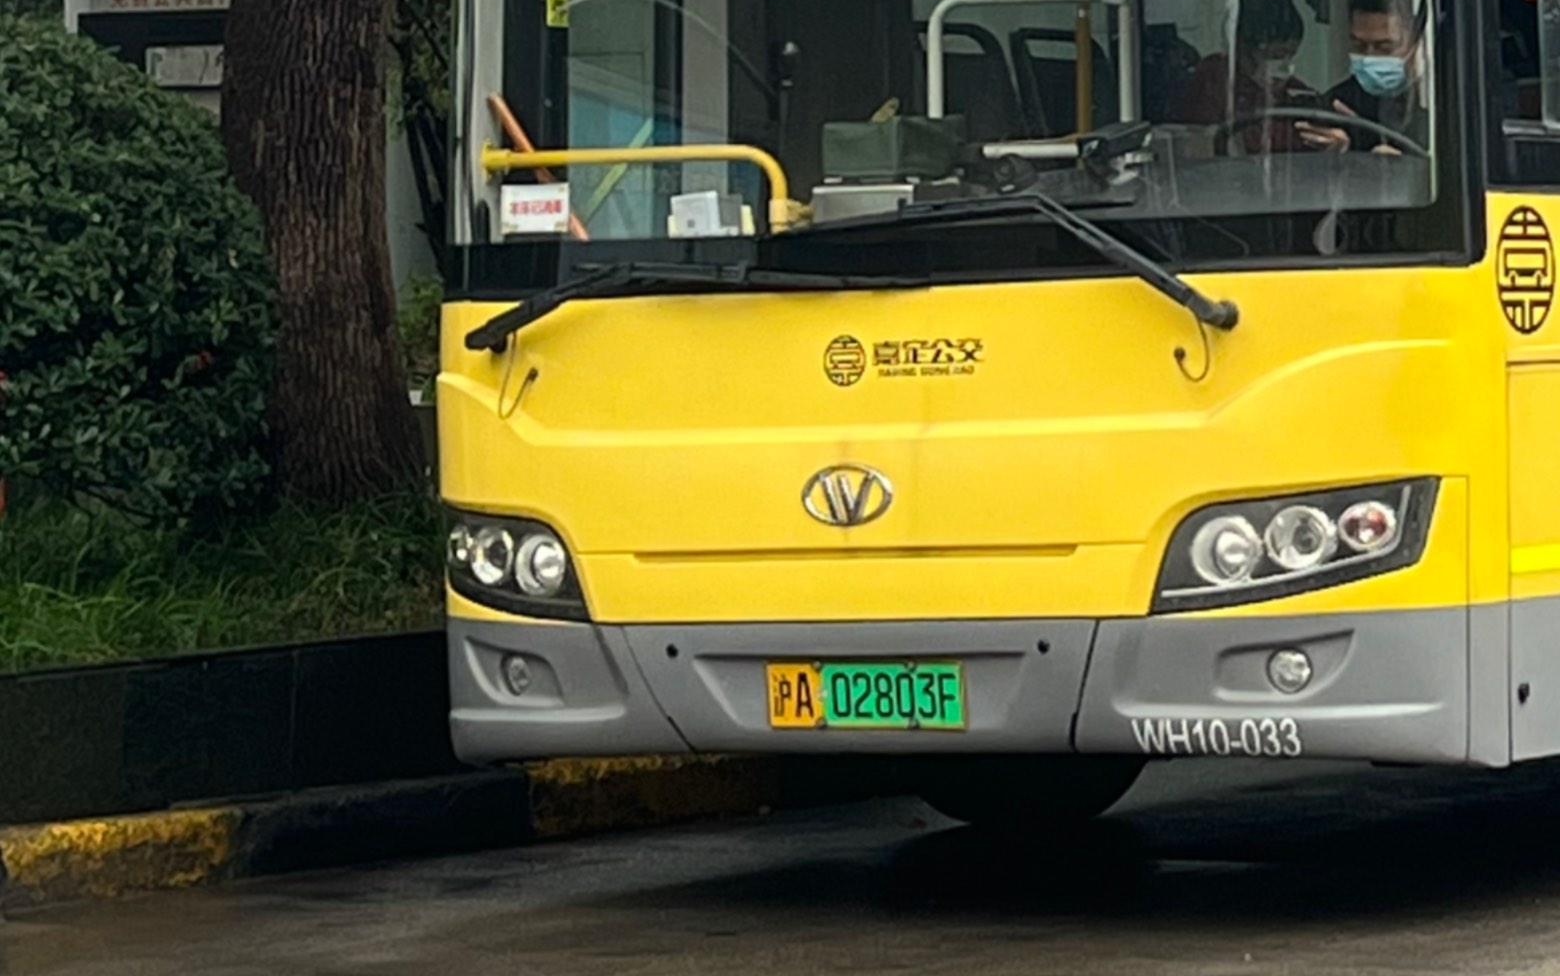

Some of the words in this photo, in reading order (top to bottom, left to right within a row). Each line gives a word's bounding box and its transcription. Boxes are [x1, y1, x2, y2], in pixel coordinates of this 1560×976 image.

[872, 338, 985, 366] 嘉定公交
[1130, 717, 1302, 756] WH10-033
